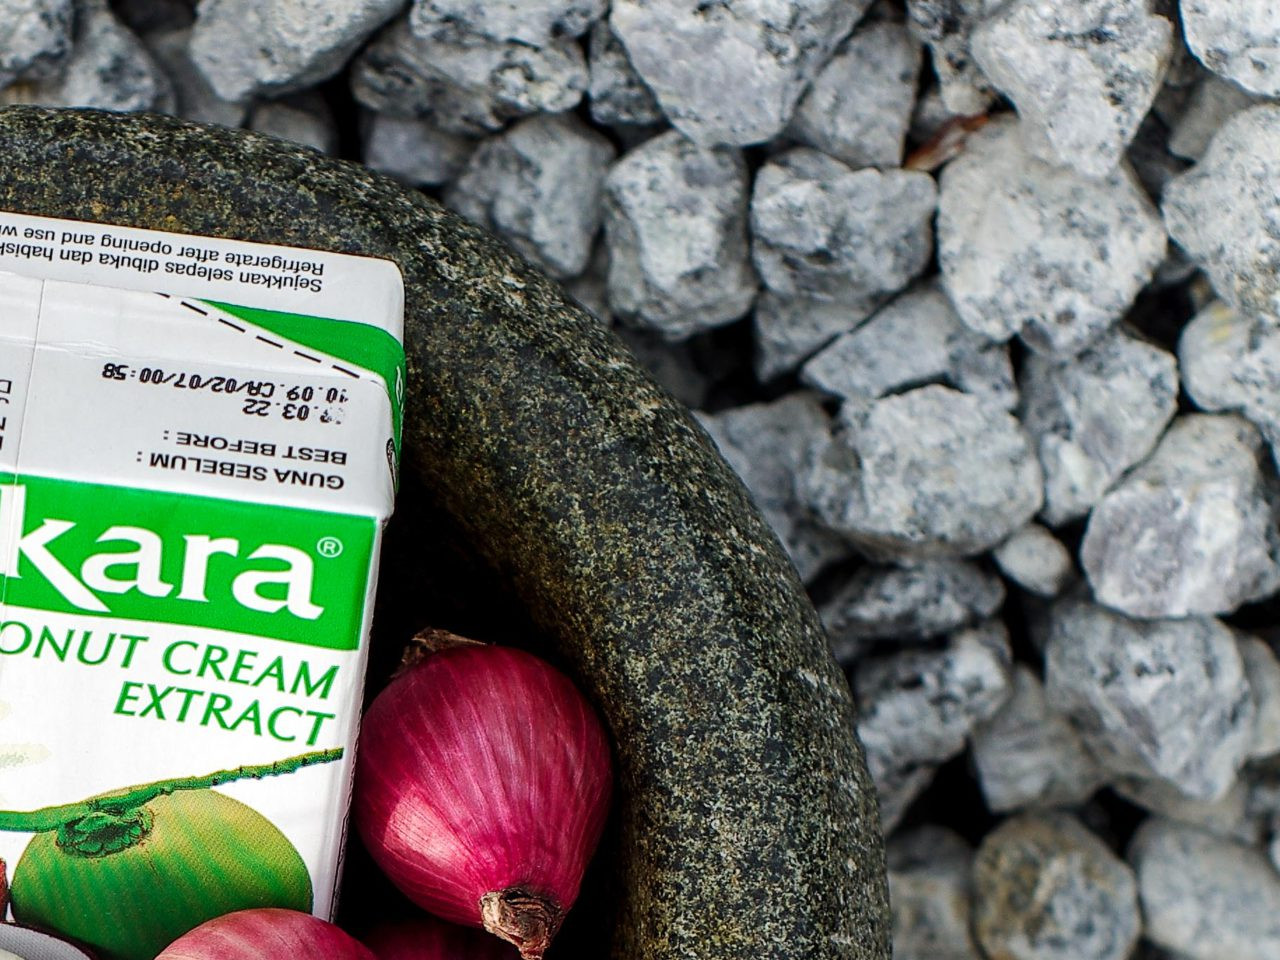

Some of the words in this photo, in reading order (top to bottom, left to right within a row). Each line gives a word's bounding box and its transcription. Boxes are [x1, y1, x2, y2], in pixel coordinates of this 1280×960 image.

[24, 227, 55, 241] use
[62, 232, 95, 246] and
[101, 234, 171, 255] opening
[59, 249, 93, 265] dan
[99, 252, 159, 273] dibuka
[177, 246, 219, 263] after
[225, 252, 325, 276] Refrigerate
[165, 262, 234, 282] selepas
[239, 271, 322, 293] Sejukkan
[282, 446, 348, 465] BEST
[275, 468, 345, 490] GUNA
[161, 640, 341, 700] CREAM
[113, 680, 336, 748] EXTRACT
